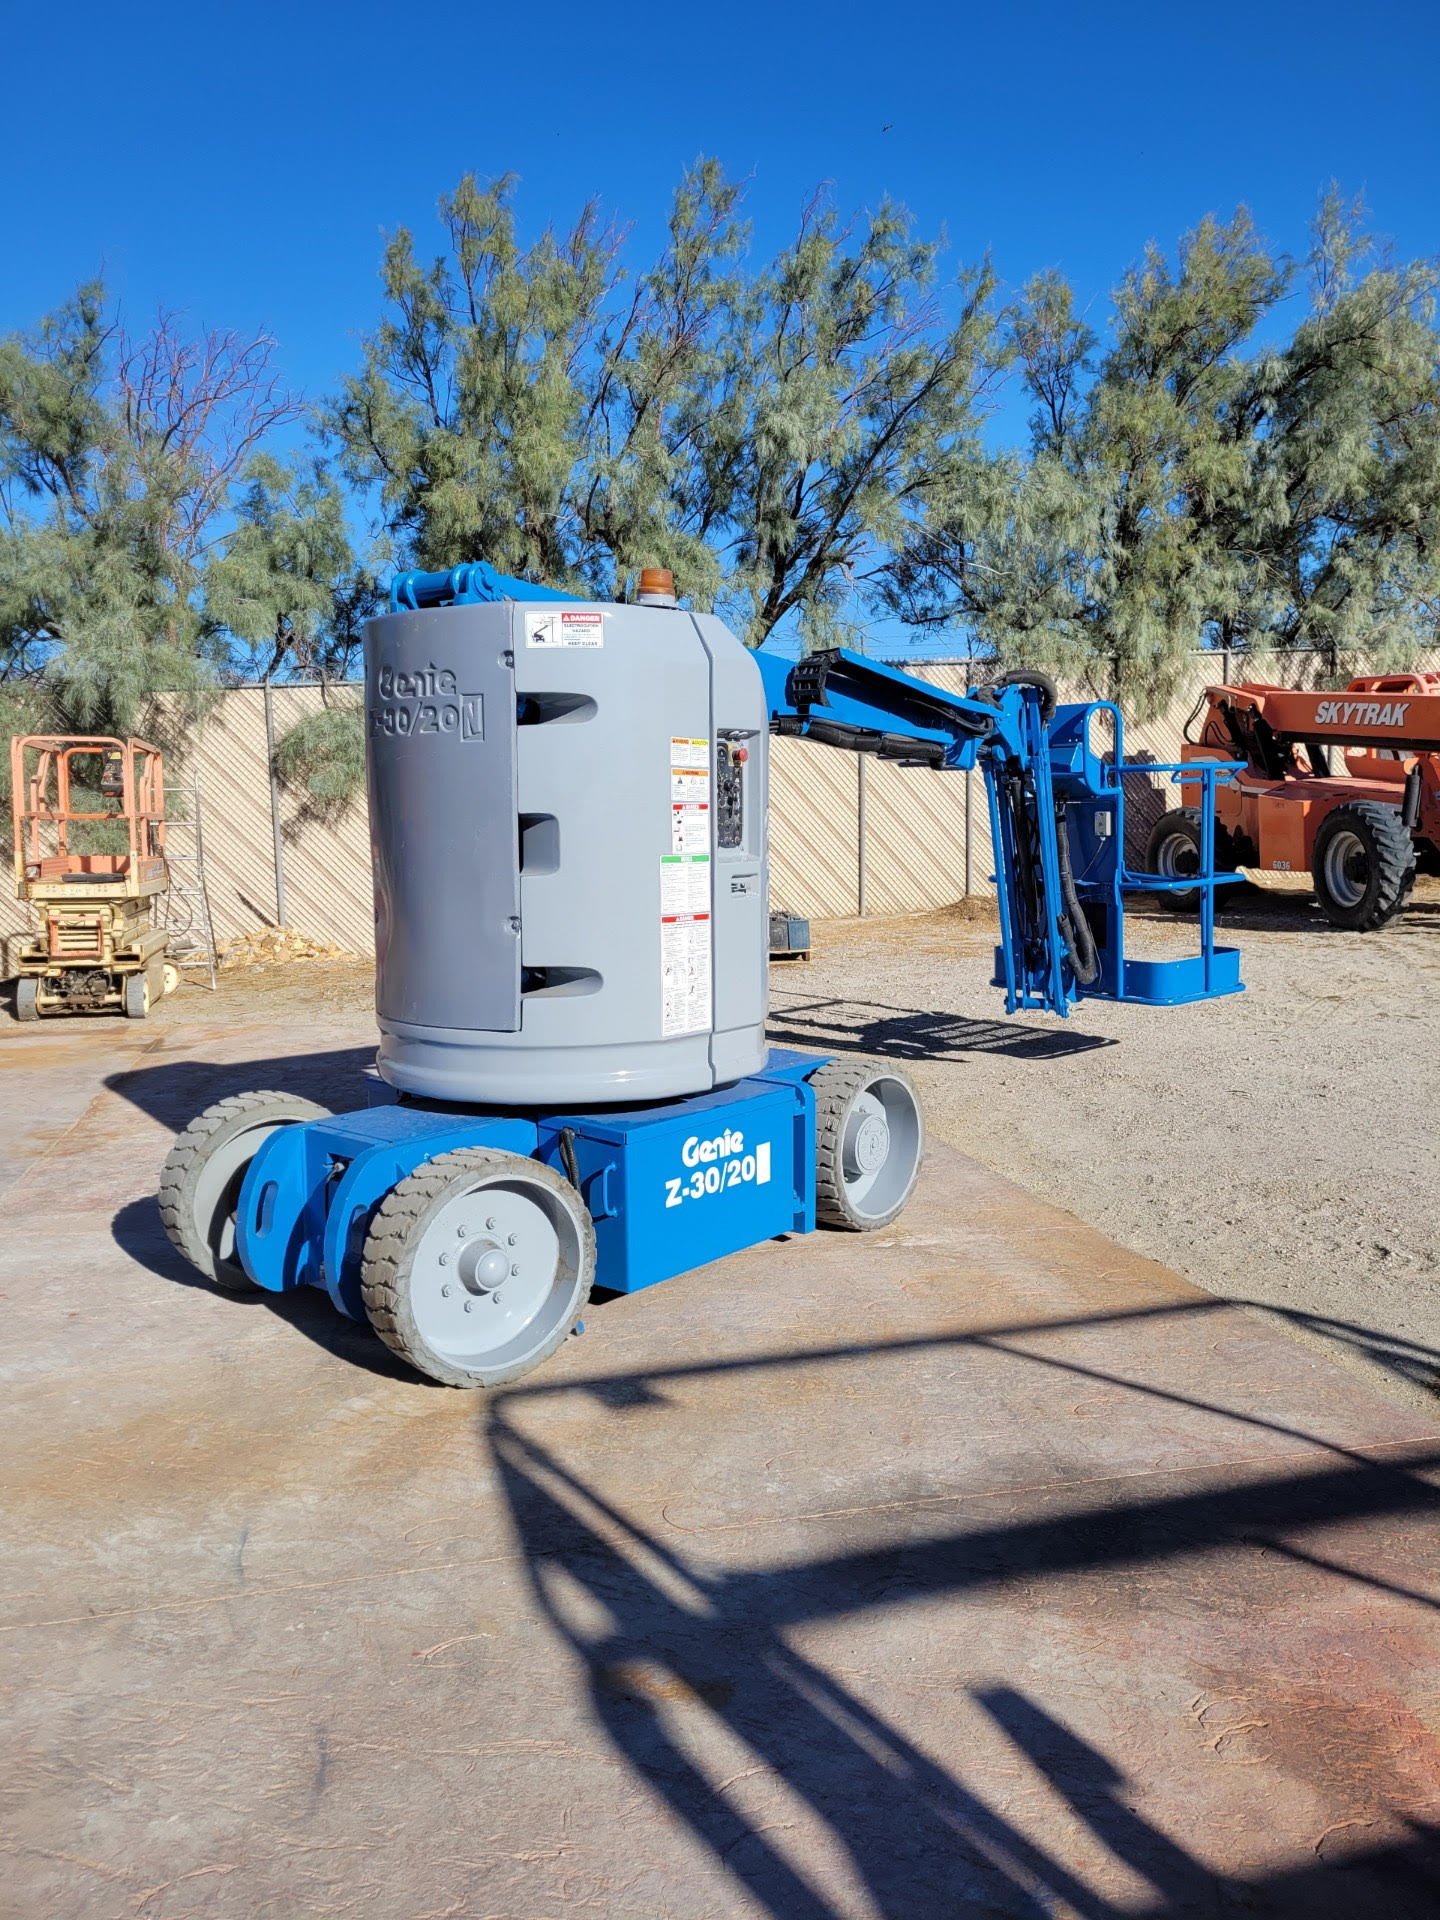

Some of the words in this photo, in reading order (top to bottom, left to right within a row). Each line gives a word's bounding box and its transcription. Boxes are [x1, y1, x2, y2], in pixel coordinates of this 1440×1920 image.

[570, 614, 600, 622] DANGER
[379, 661, 457, 700] Genie
[1314, 701, 1410, 726] SKYTRAK
[682, 1127, 744, 1168] Genie
